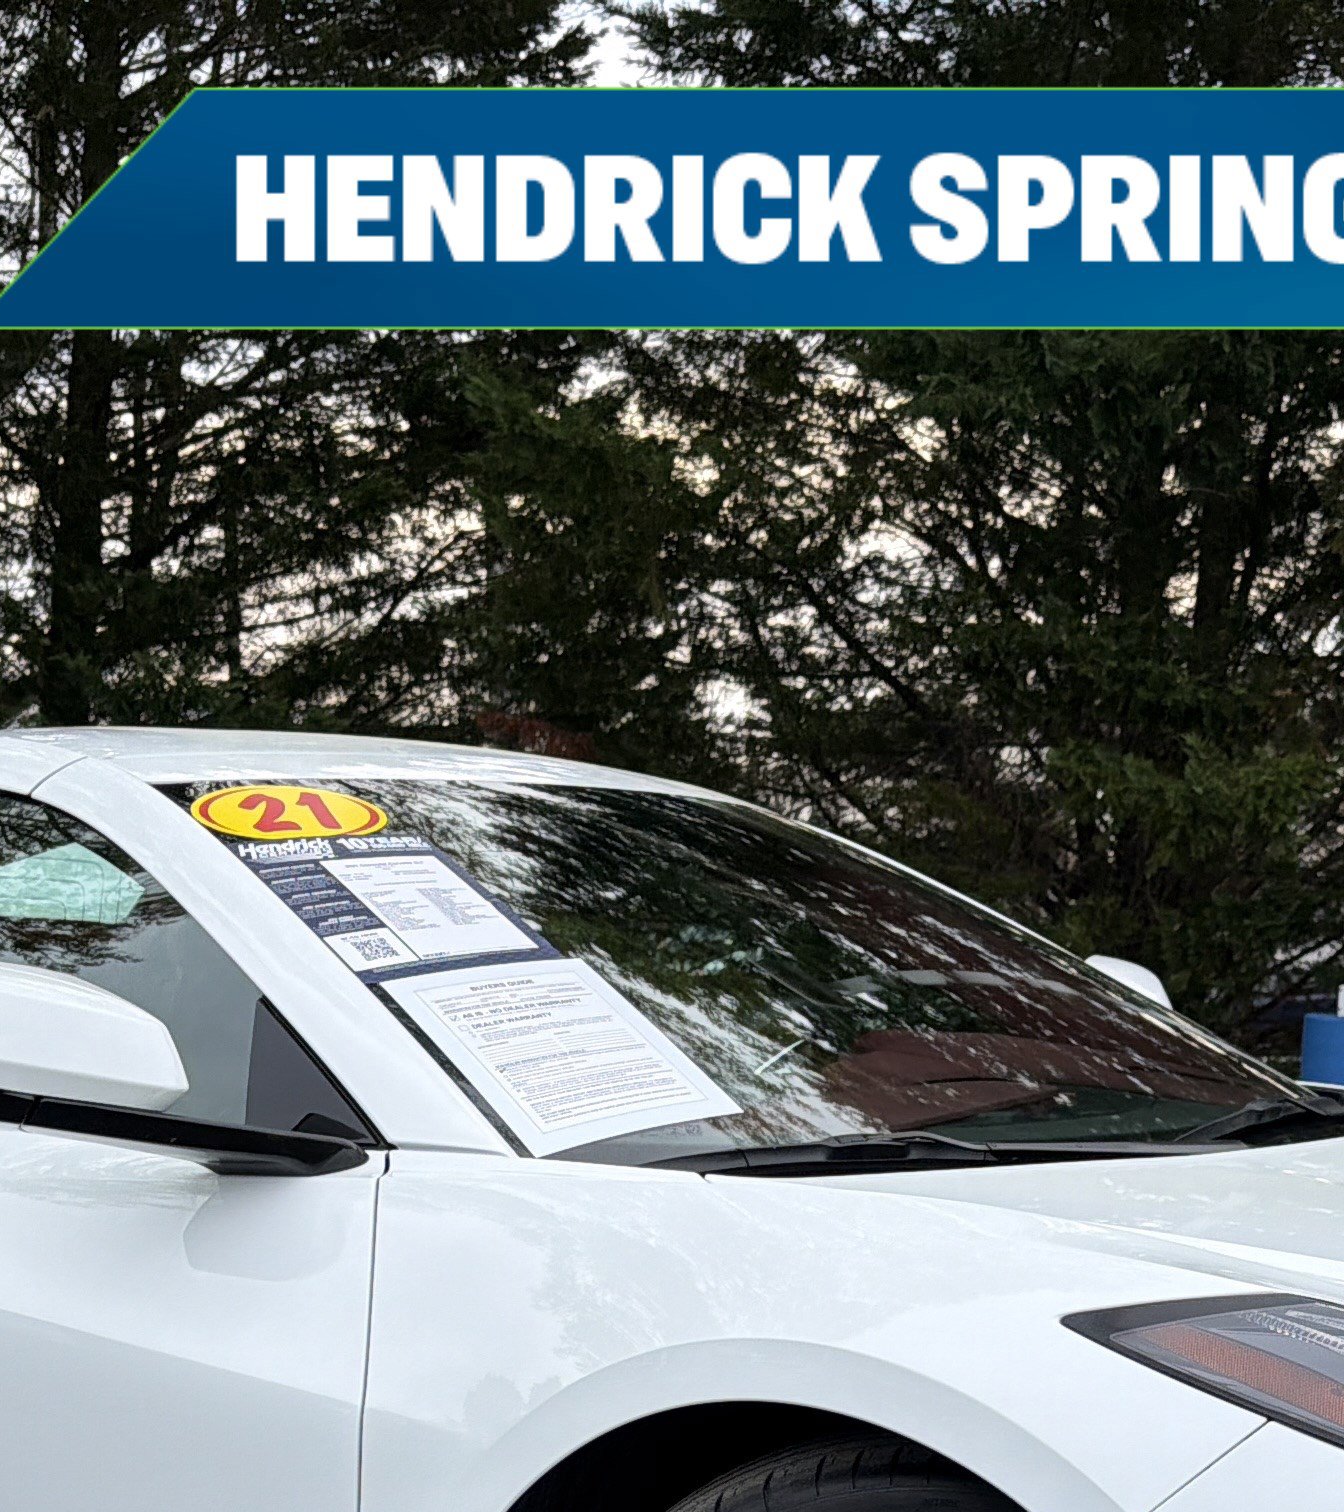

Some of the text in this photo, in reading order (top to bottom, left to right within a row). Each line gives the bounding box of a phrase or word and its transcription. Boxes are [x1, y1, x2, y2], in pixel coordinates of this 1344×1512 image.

[237, 791, 343, 833] 21
[237, 837, 333, 860] Hendrick
[503, 1003, 536, 1013] DEALER
[536, 998, 582, 1009] WARRANTY
[470, 1018, 505, 1030] DEALER
[505, 1011, 552, 1024] WARRANTY
